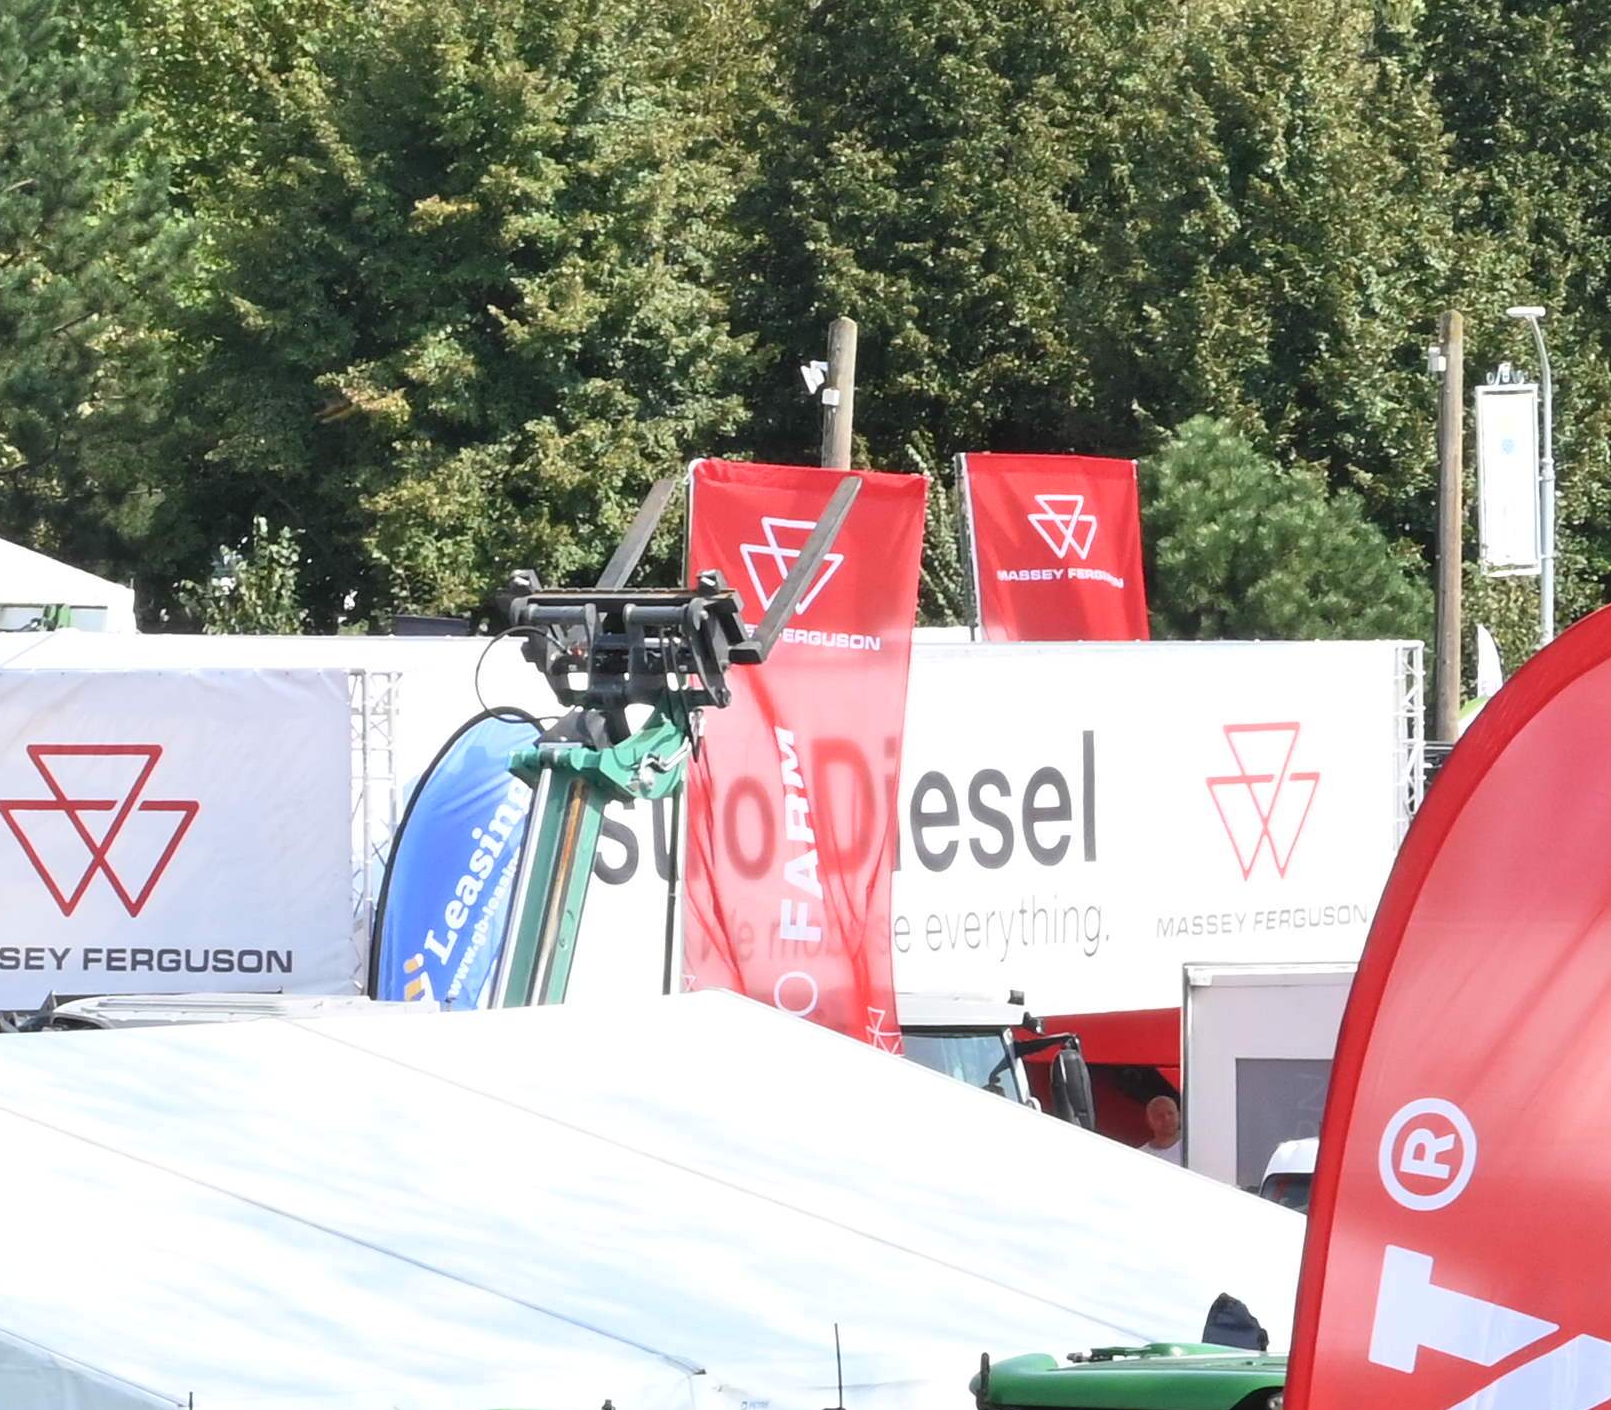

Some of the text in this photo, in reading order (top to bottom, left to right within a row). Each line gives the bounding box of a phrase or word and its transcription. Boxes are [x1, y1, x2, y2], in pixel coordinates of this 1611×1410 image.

[996, 568, 1065, 582] MASSEY
[778, 627, 881, 651] ERGUSON
[925, 894, 1110, 962] everything.
[1155, 902, 1369, 938] MASSEY FERGUSON
[82, 947, 294, 975] FERGUSON
